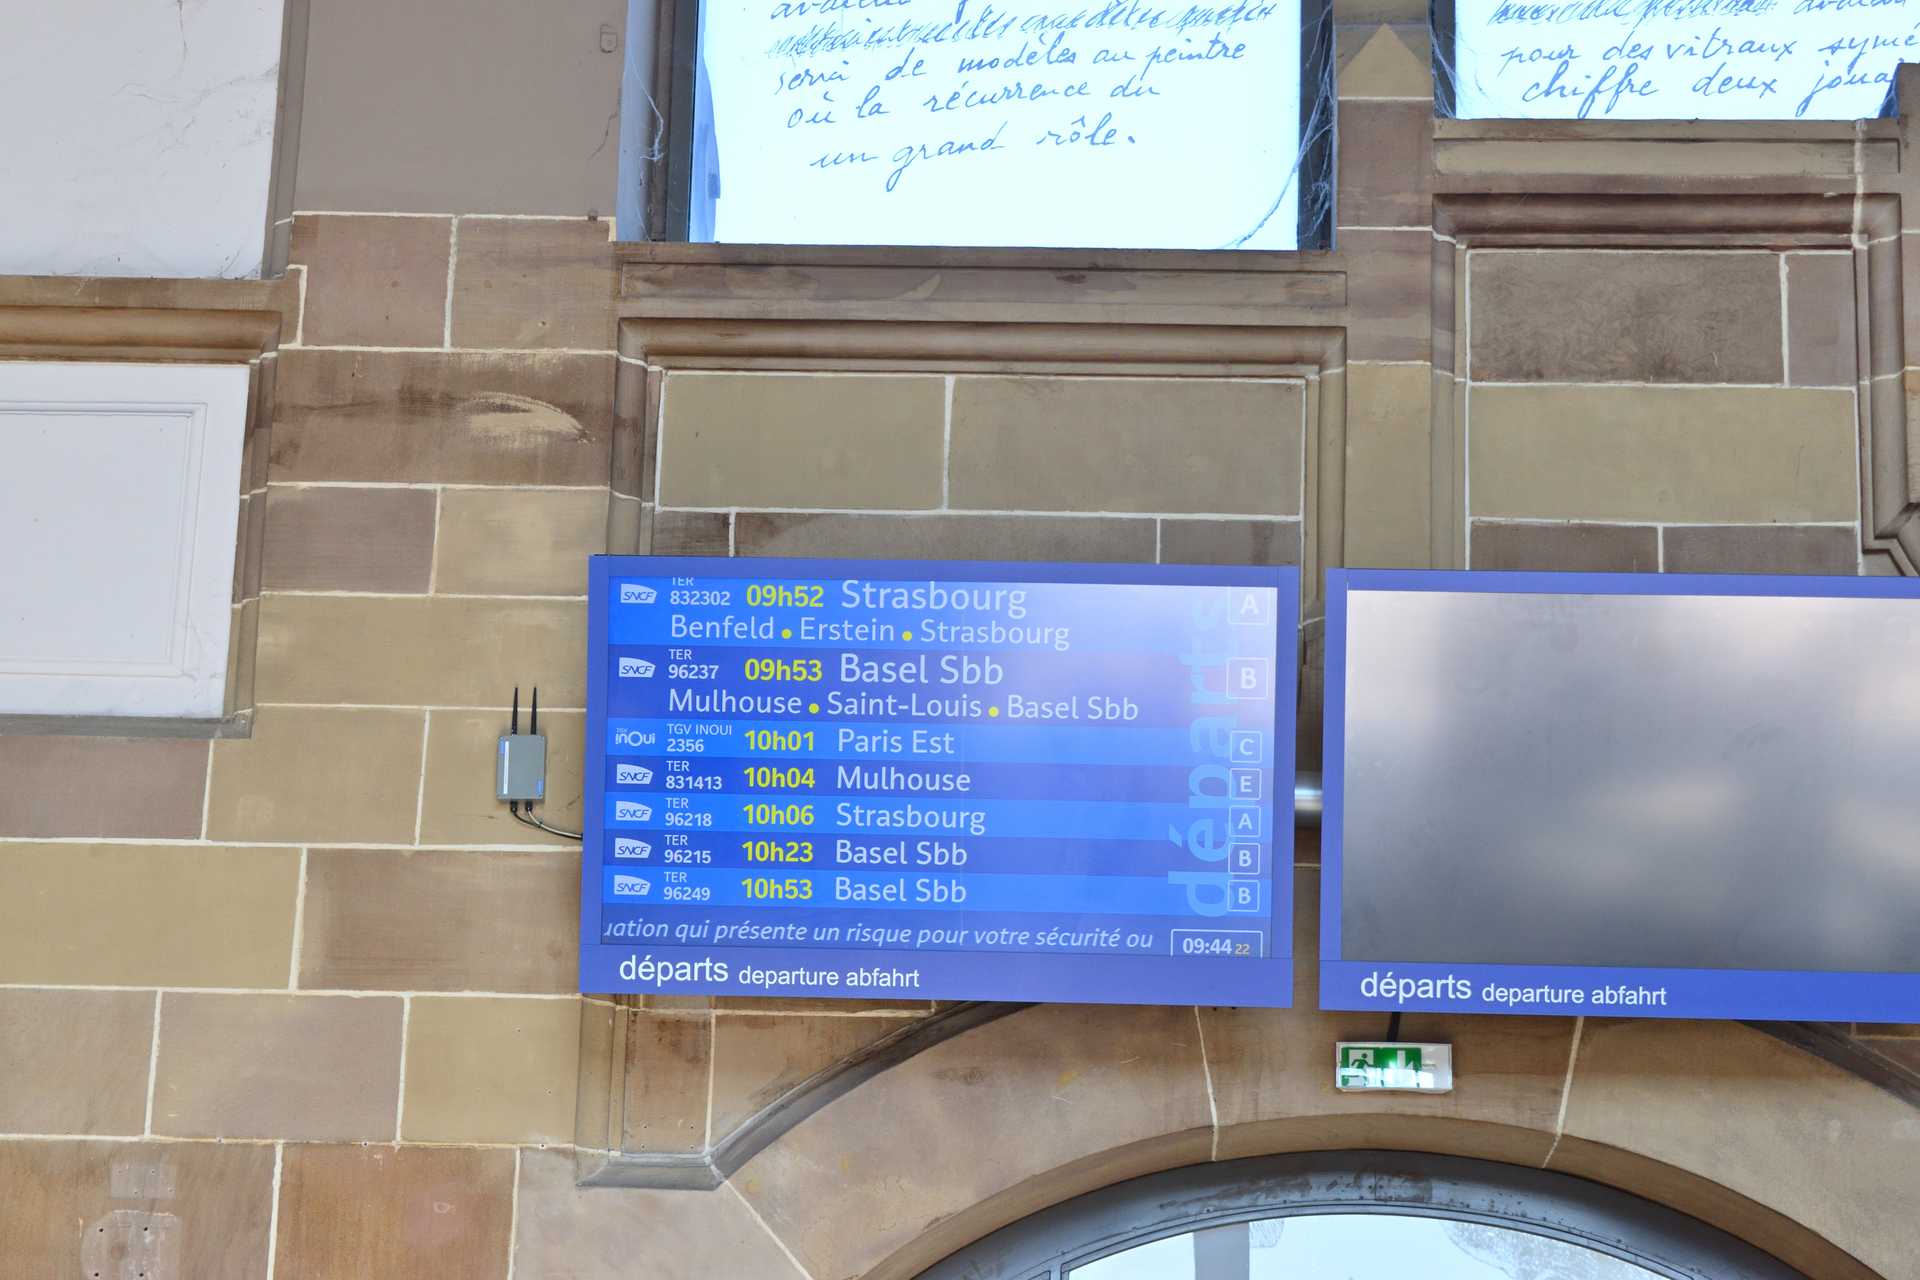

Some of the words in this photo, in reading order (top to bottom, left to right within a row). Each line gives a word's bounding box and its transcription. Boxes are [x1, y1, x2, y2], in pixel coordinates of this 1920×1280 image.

[885, 47, 926, 80] de
[958, 31, 1076, 73] modèles
[1093, 48, 1136, 64] au
[1140, 32, 1246, 81] peintre
[1497, 44, 1582, 77] pour
[1602, 30, 1654, 60] des
[1667, 27, 1797, 62] vitraux
[1522, 60, 1659, 119] chiffre
[1692, 62, 1777, 98] deux
[788, 91, 836, 128] où
[856, 85, 890, 119] la
[923, 81, 1091, 112] récurrence
[810, 152, 879, 168] un
[886, 121, 1008, 193] grand
[1036, 112, 1136, 146] rôle.
[623, 591, 654, 601] SNCF
[670, 591, 731, 606] 832302
[746, 585, 824, 608] 09h52
[841, 579, 1027, 619] Strasbourg
[1240, 593, 1260, 615] A
[671, 614, 774, 640] Benfeld
[801, 617, 895, 642] Erstein
[920, 619, 1070, 651] Strasbourg
[668, 649, 692, 660] TER
[621, 664, 653, 675] SNCF
[668, 664, 719, 680] 96237
[744, 658, 823, 682] 09h53
[840, 653, 928, 684] Basel
[940, 655, 1004, 685] Sbb
[1240, 667, 1257, 689] B
[669, 689, 801, 714] Mulhouse
[827, 691, 982, 718] Saint-Louis
[1007, 694, 1079, 719] Basel
[1088, 696, 1138, 721] Sbb
[666, 738, 704, 752] 2356
[744, 730, 814, 751] 10h01
[838, 728, 902, 753] Paris
[912, 729, 954, 754] Est
[1239, 738, 1254, 756] C
[667, 724, 691, 735] TGV
[695, 724, 732, 736] INOUI
[619, 771, 649, 782] SNCF
[665, 776, 722, 790] 831413
[743, 767, 815, 788] 10h04
[836, 765, 971, 791] Mulhouse
[1240, 776, 1253, 793] E
[666, 761, 690, 772] TER
[618, 808, 649, 819] SNCF
[665, 798, 689, 809] TER
[665, 812, 712, 827] 96218
[743, 804, 815, 825] 10h06
[836, 802, 986, 836] Strasbourg
[1238, 813, 1253, 830] A
[617, 845, 648, 856] SNCF
[664, 849, 712, 864] 96215
[742, 841, 813, 862] 10h23
[836, 839, 908, 865] Basel
[916, 841, 968, 866] Sbb
[1239, 850, 1252, 867] B
[665, 835, 688, 846] TER
[616, 882, 647, 893] SNCF
[663, 886, 711, 901] 96249
[741, 878, 812, 899] 10h53
[835, 876, 907, 902] Basel
[915, 878, 967, 903] Sbb
[1238, 887, 1251, 905] B
[664, 871, 687, 883] TER
[675, 919, 710, 943] qui
[714, 920, 808, 943] présente
[813, 926, 840, 942] un
[846, 922, 912, 948] risque
[916, 928, 968, 948] pour
[974, 927, 1030, 946] votre
[1035, 927, 1121, 948] sécurité
[1127, 933, 1153, 948] ou
[1183, 938, 1232, 955] 09:44
[1235, 943, 1250, 955] 22
[619, 954, 729, 988] départs
[738, 966, 840, 989] departure
[846, 967, 920, 988] abfahrt
[1360, 972, 1472, 1004] départs
[1482, 983, 1585, 1007] departure
[1591, 986, 1667, 1007] abfahrt
